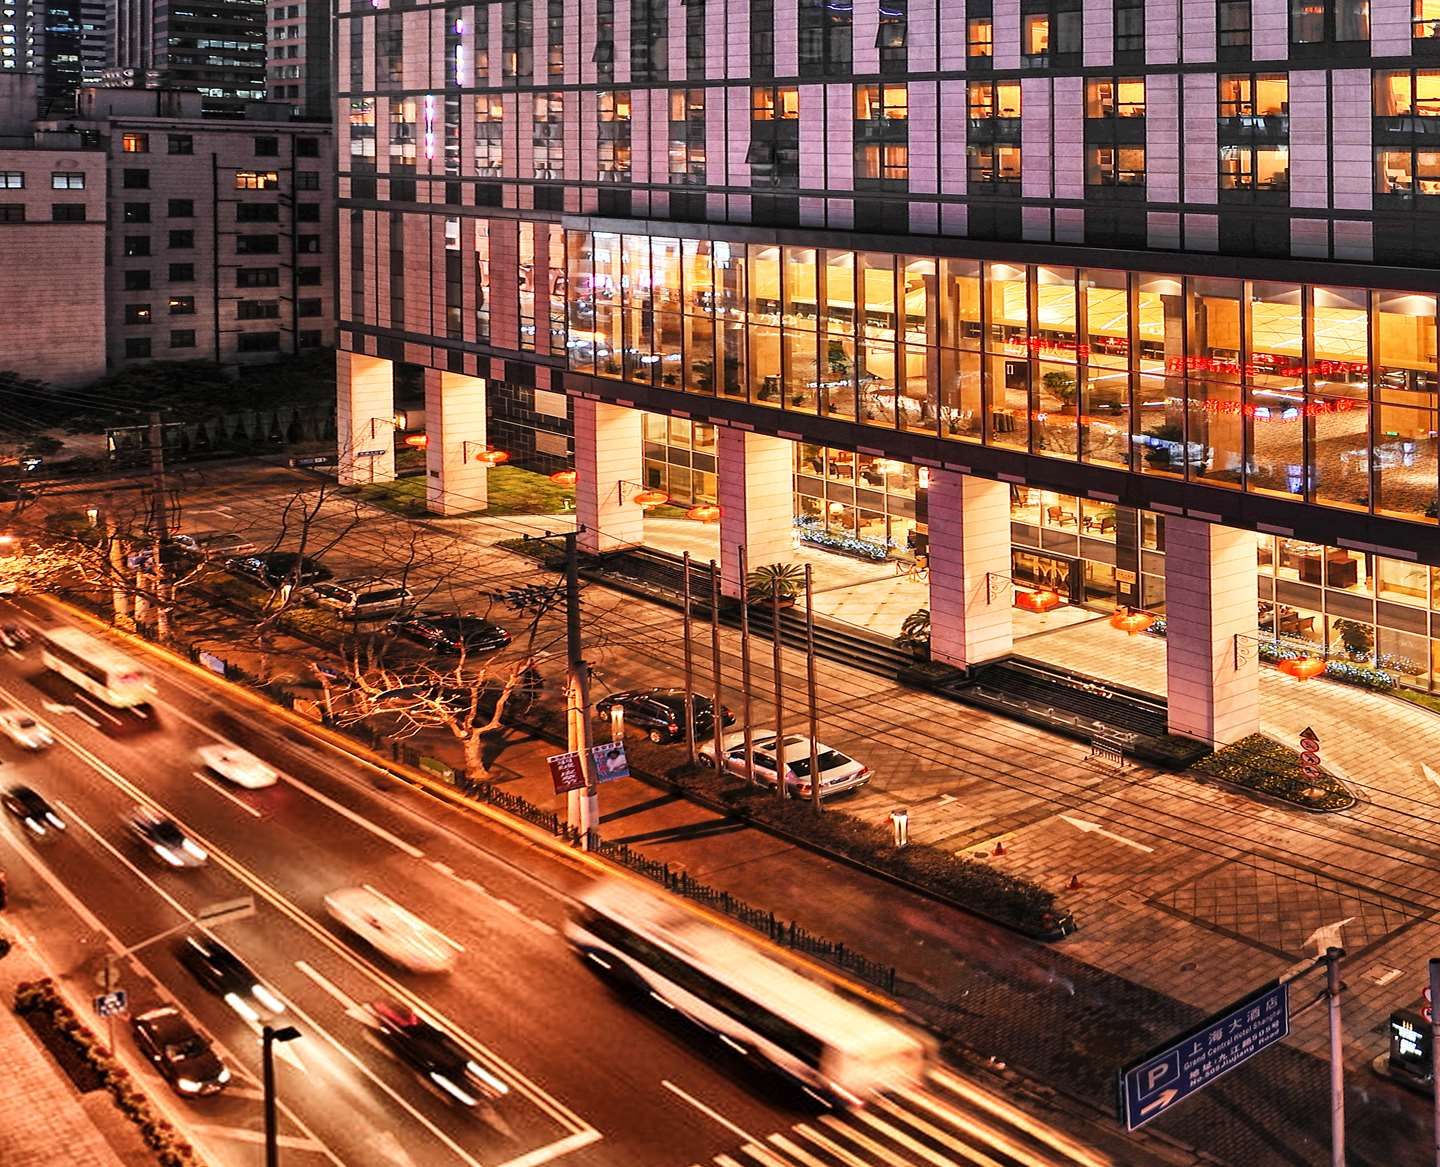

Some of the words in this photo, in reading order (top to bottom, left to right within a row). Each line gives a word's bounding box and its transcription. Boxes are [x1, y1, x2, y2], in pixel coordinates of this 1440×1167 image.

[1188, 996, 1278, 1057] 上海大酒店
[1184, 1052, 1207, 1071] Grand
[1207, 1035, 1233, 1056] Central
[1148, 1063, 1169, 1089] P
